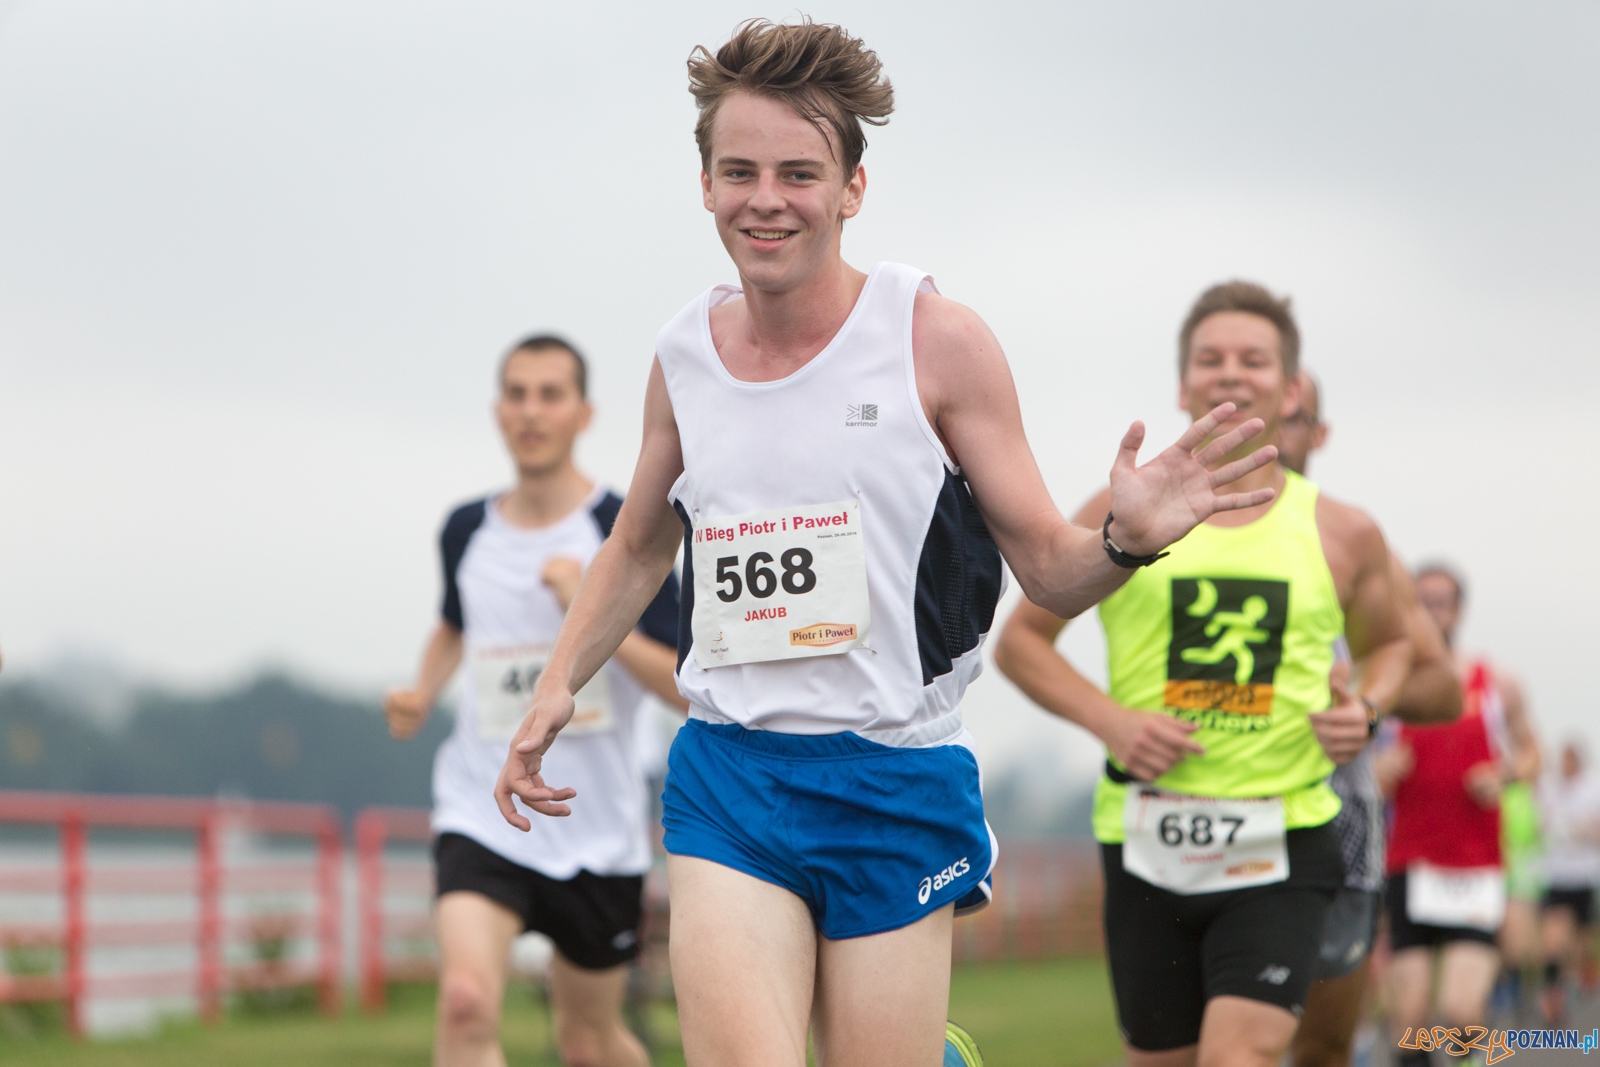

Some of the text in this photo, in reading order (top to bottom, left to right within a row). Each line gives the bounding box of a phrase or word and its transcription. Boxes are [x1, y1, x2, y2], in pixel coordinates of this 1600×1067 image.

[705, 527, 735, 542] Bieg
[739, 520, 776, 537] Piotr
[781, 517, 787, 531] i
[792, 511, 849, 530] Paweł
[716, 547, 817, 603] 568
[744, 606, 788, 622] JAKUB
[792, 631, 817, 641] Piotr
[819, 629, 823, 639] i
[825, 627, 854, 638] Paweł
[1159, 813, 1247, 847] 687
[933, 856, 971, 891] asics
